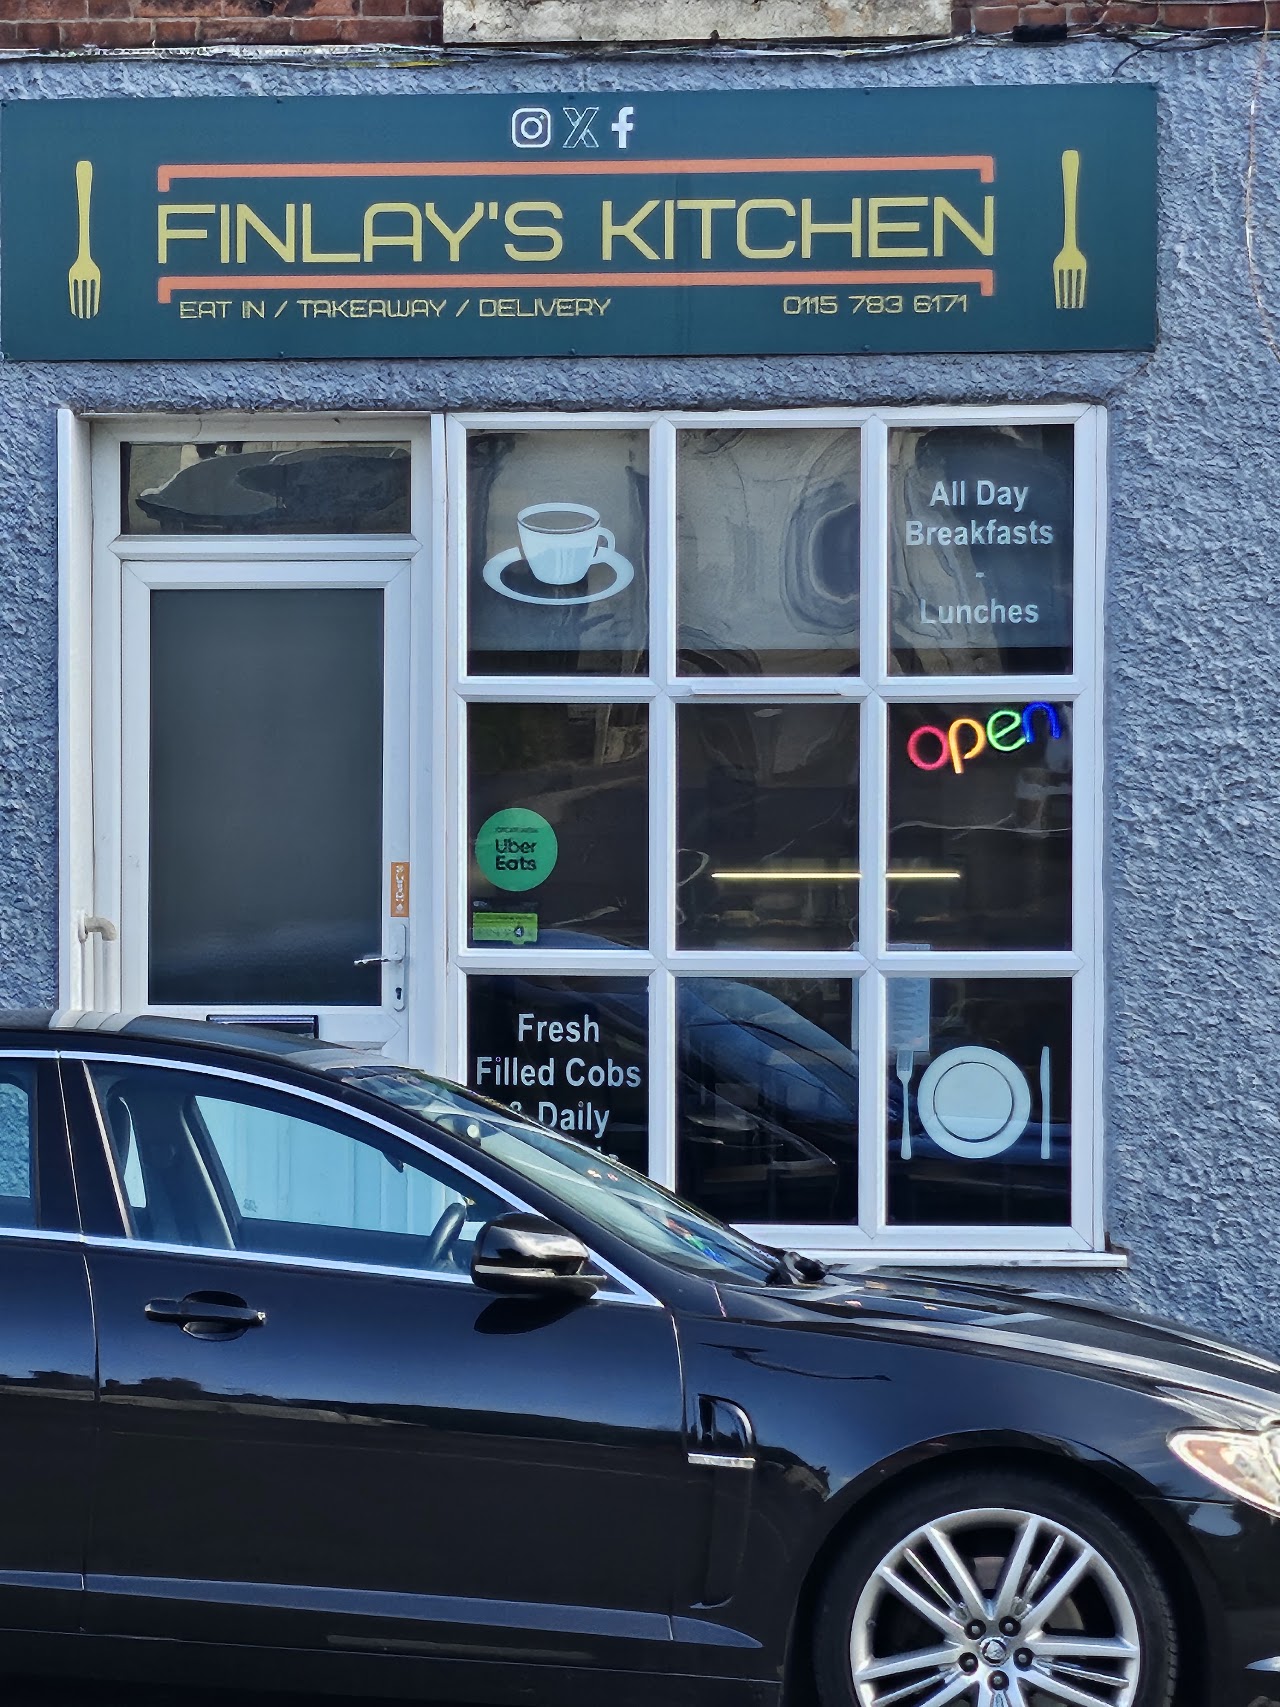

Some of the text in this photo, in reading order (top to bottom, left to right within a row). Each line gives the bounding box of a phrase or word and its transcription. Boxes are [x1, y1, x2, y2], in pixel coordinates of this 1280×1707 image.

[157, 195, 995, 264] FINLAY'S KITCHEN
[179, 300, 233, 319] EAT
[242, 300, 265, 319] IN
[296, 299, 447, 319] TAKEAWAY
[479, 298, 612, 317] DELIVERY
[783, 294, 968, 315] 0115 783 6171
[929, 480, 1029, 512] All Day
[905, 519, 1054, 546] Breakfasts
[920, 598, 1040, 625] Lunches
[907, 701, 1061, 775] open
[496, 838, 537, 854] Uber
[496, 855, 537, 871] Eats
[518, 1013, 600, 1043] Fresh
[476, 1056, 642, 1088] Filled Cobs
[538, 1101, 610, 1139] Daily
